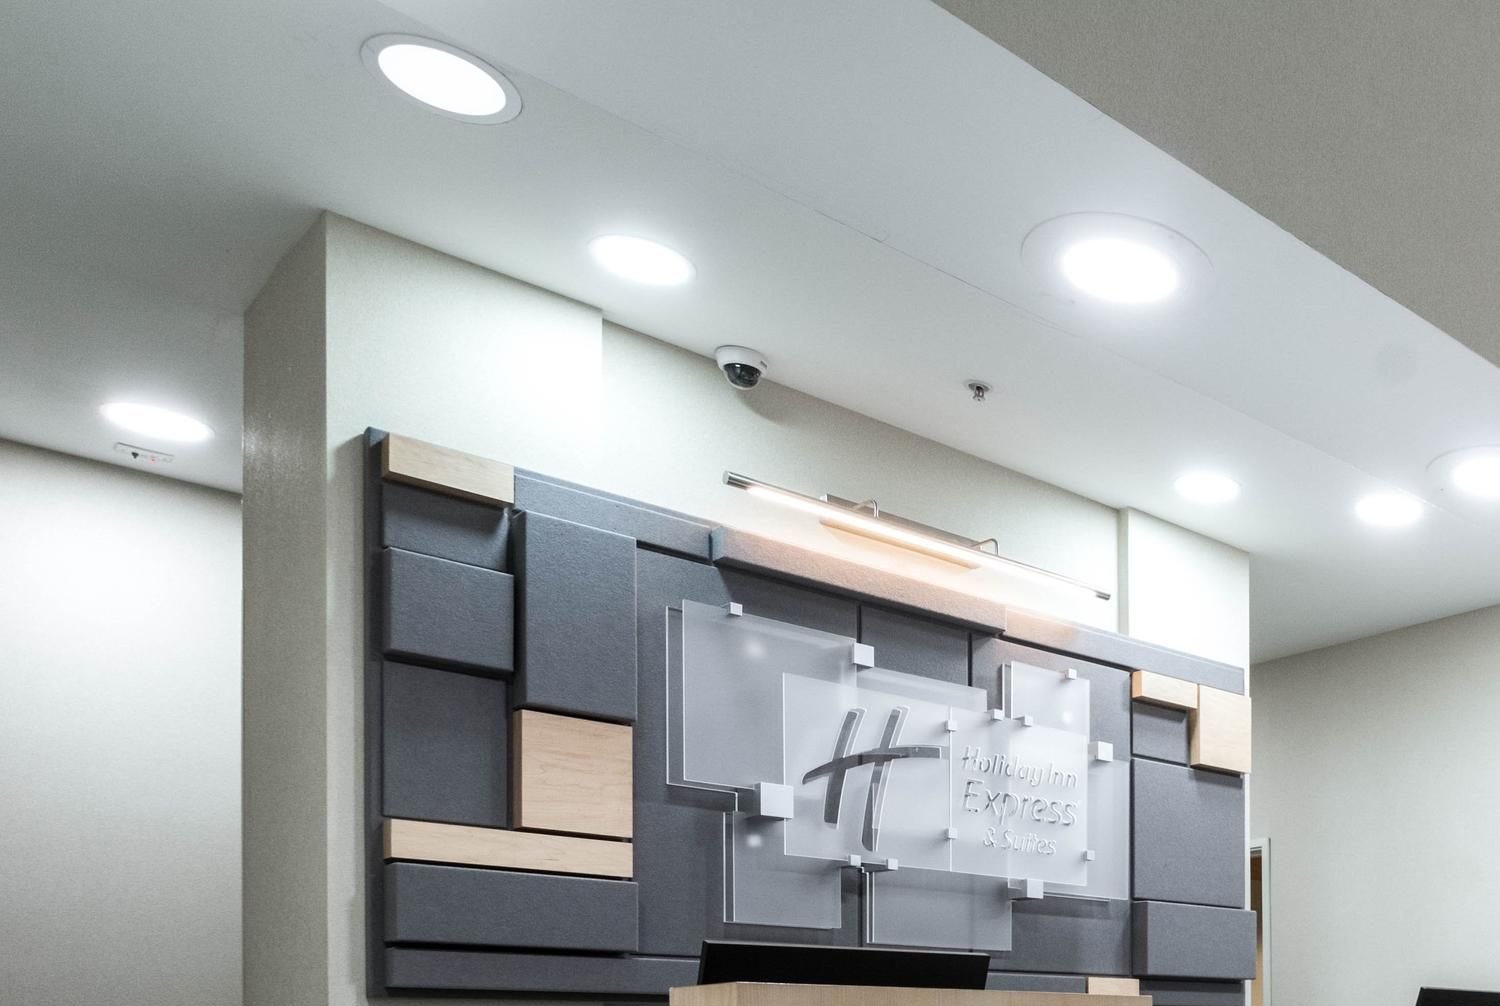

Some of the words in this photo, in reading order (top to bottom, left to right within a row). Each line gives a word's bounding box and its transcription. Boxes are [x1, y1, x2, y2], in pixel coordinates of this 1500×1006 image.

[962, 745, 1045, 787] Holiday
[1047, 761, 1079, 788] Inn
[962, 778, 1080, 826] Express
[983, 826, 997, 848] &
[999, 828, 1057, 856] Suites
